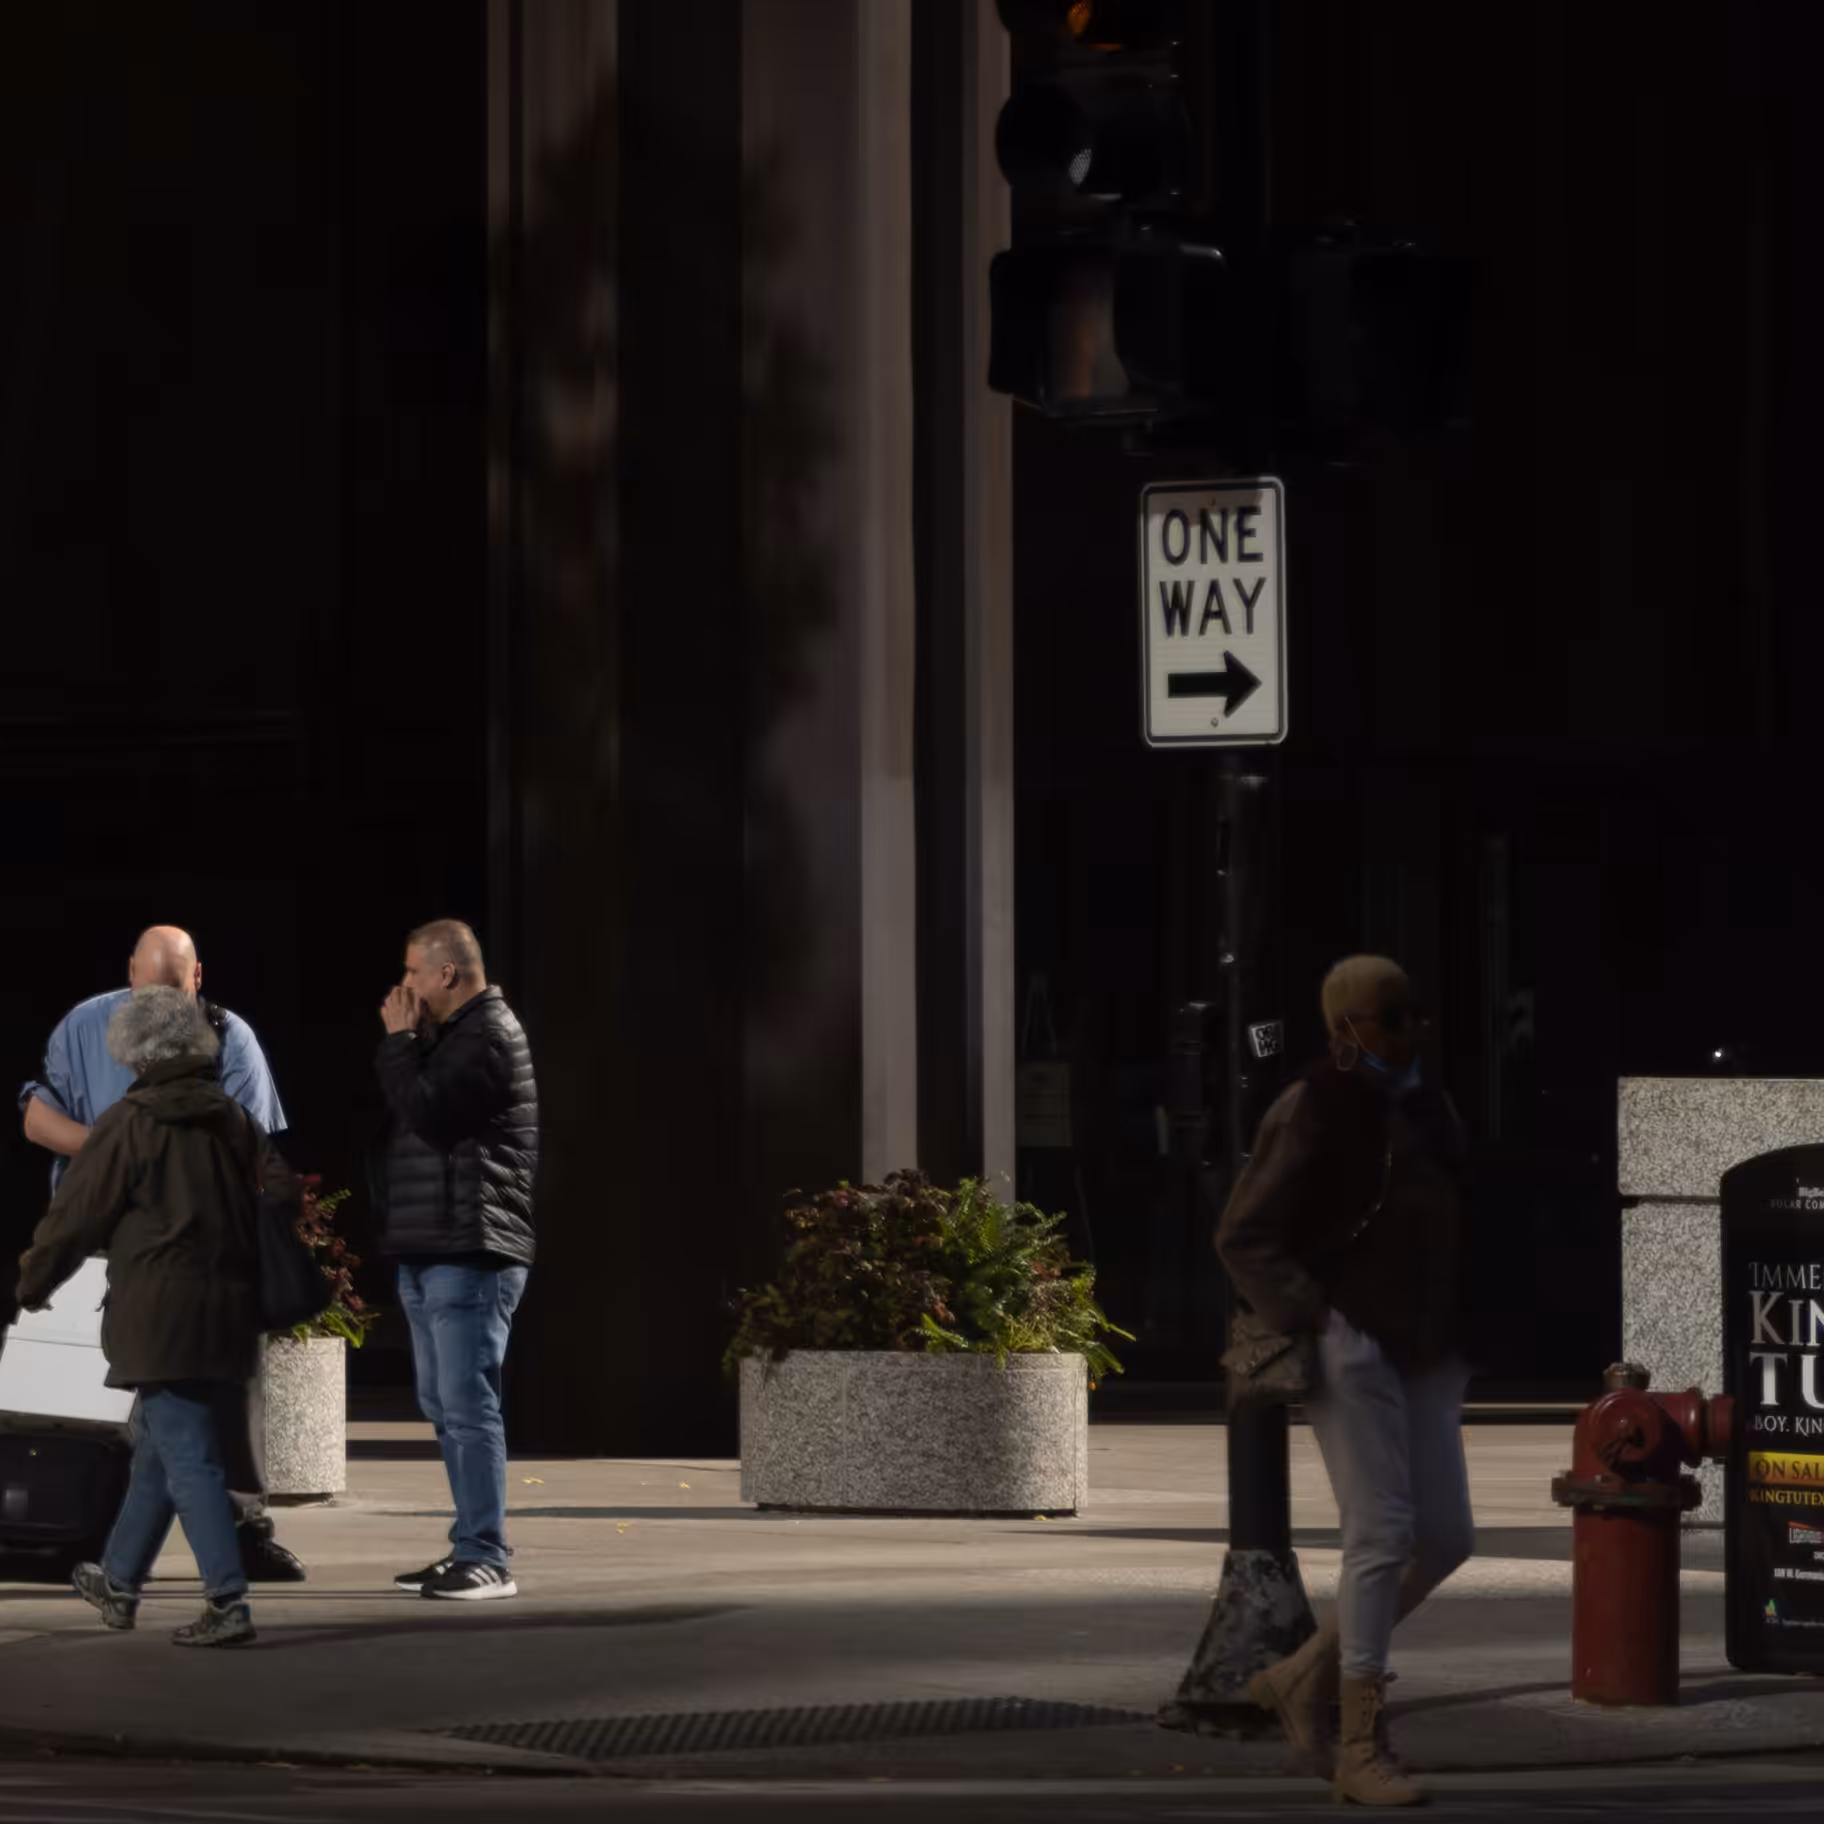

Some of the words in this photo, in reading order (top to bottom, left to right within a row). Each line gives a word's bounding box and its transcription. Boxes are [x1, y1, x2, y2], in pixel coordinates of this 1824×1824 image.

[1162, 505, 1264, 566] ONE
[1159, 577, 1266, 637] WAY
[1755, 1459, 1786, 1479] ON
